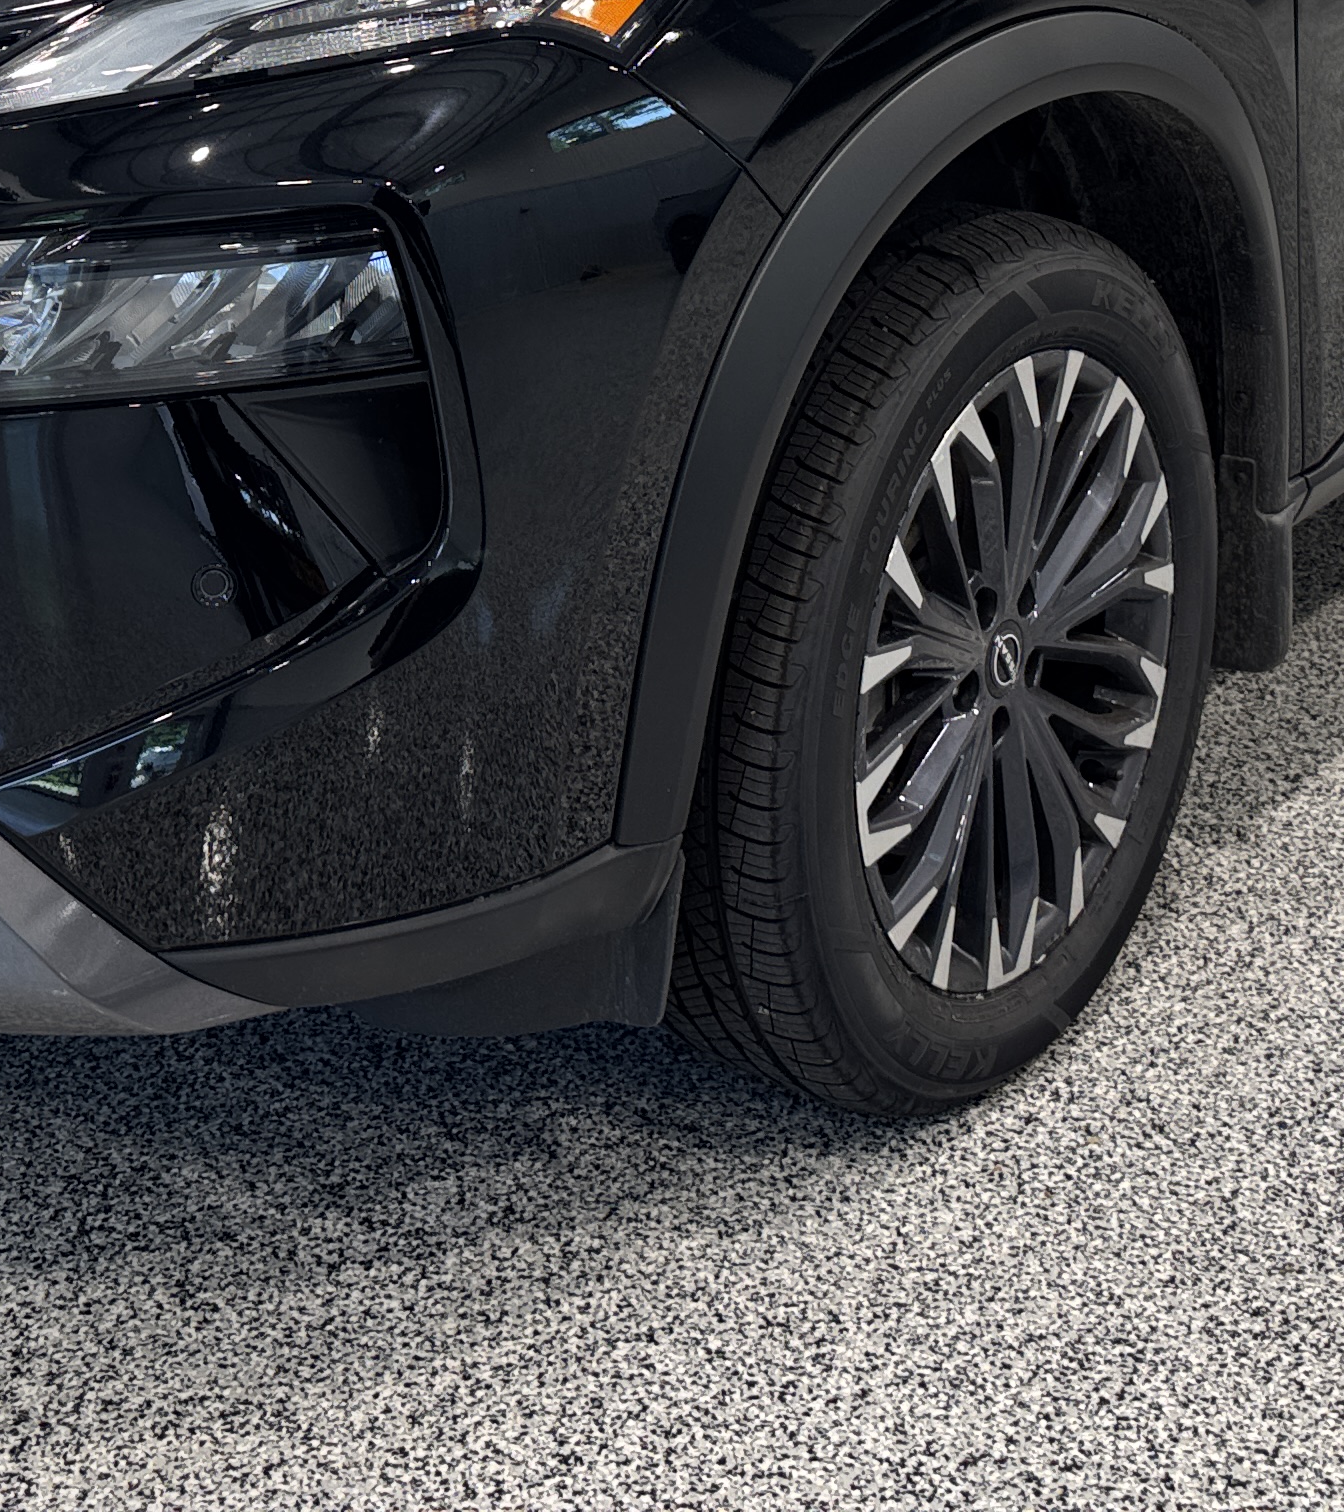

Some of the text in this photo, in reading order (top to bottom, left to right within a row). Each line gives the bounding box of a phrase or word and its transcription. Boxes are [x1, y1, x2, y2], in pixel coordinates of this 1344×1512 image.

[1091, 278, 1178, 361] KELLY
[831, 367, 954, 719] EDGE TOURING PLUS
[884, 1018, 999, 1081] KELLY
